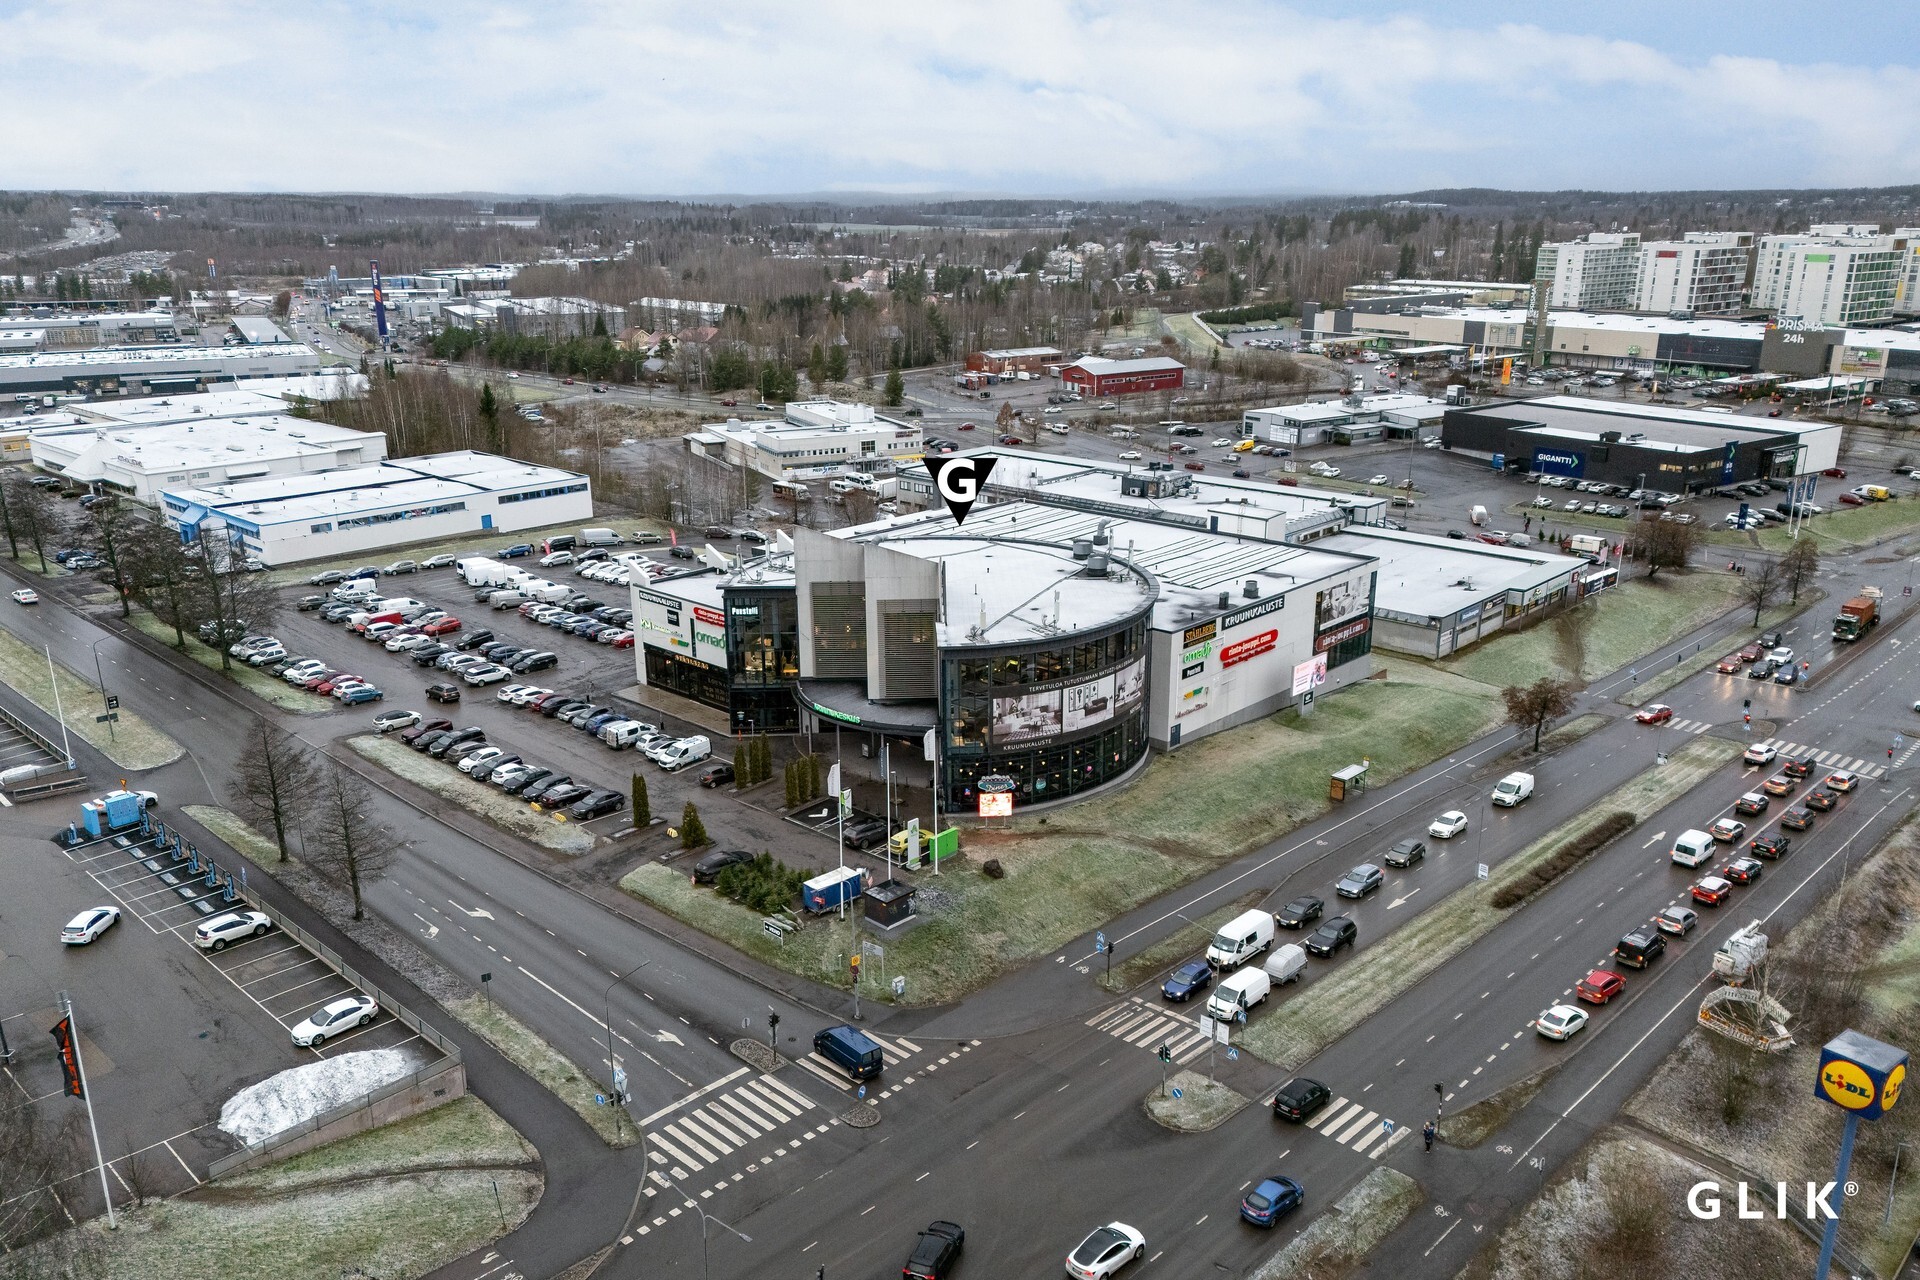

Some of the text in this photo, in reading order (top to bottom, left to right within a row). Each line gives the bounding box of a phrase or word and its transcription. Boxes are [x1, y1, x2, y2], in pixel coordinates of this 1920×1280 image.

[1777, 319, 1824, 332] PRISMA
[1783, 333, 1804, 344] 24h
[1538, 453, 1572, 465] GIGANTTI
[1225, 599, 1284, 628] KRUUNUKALUSTE
[1028, 682, 1063, 693] TERVETULOA
[1063, 672, 1099, 687] TUTUSTUMAAN
[1003, 738, 1053, 751] KRUUNUKALUSTE
